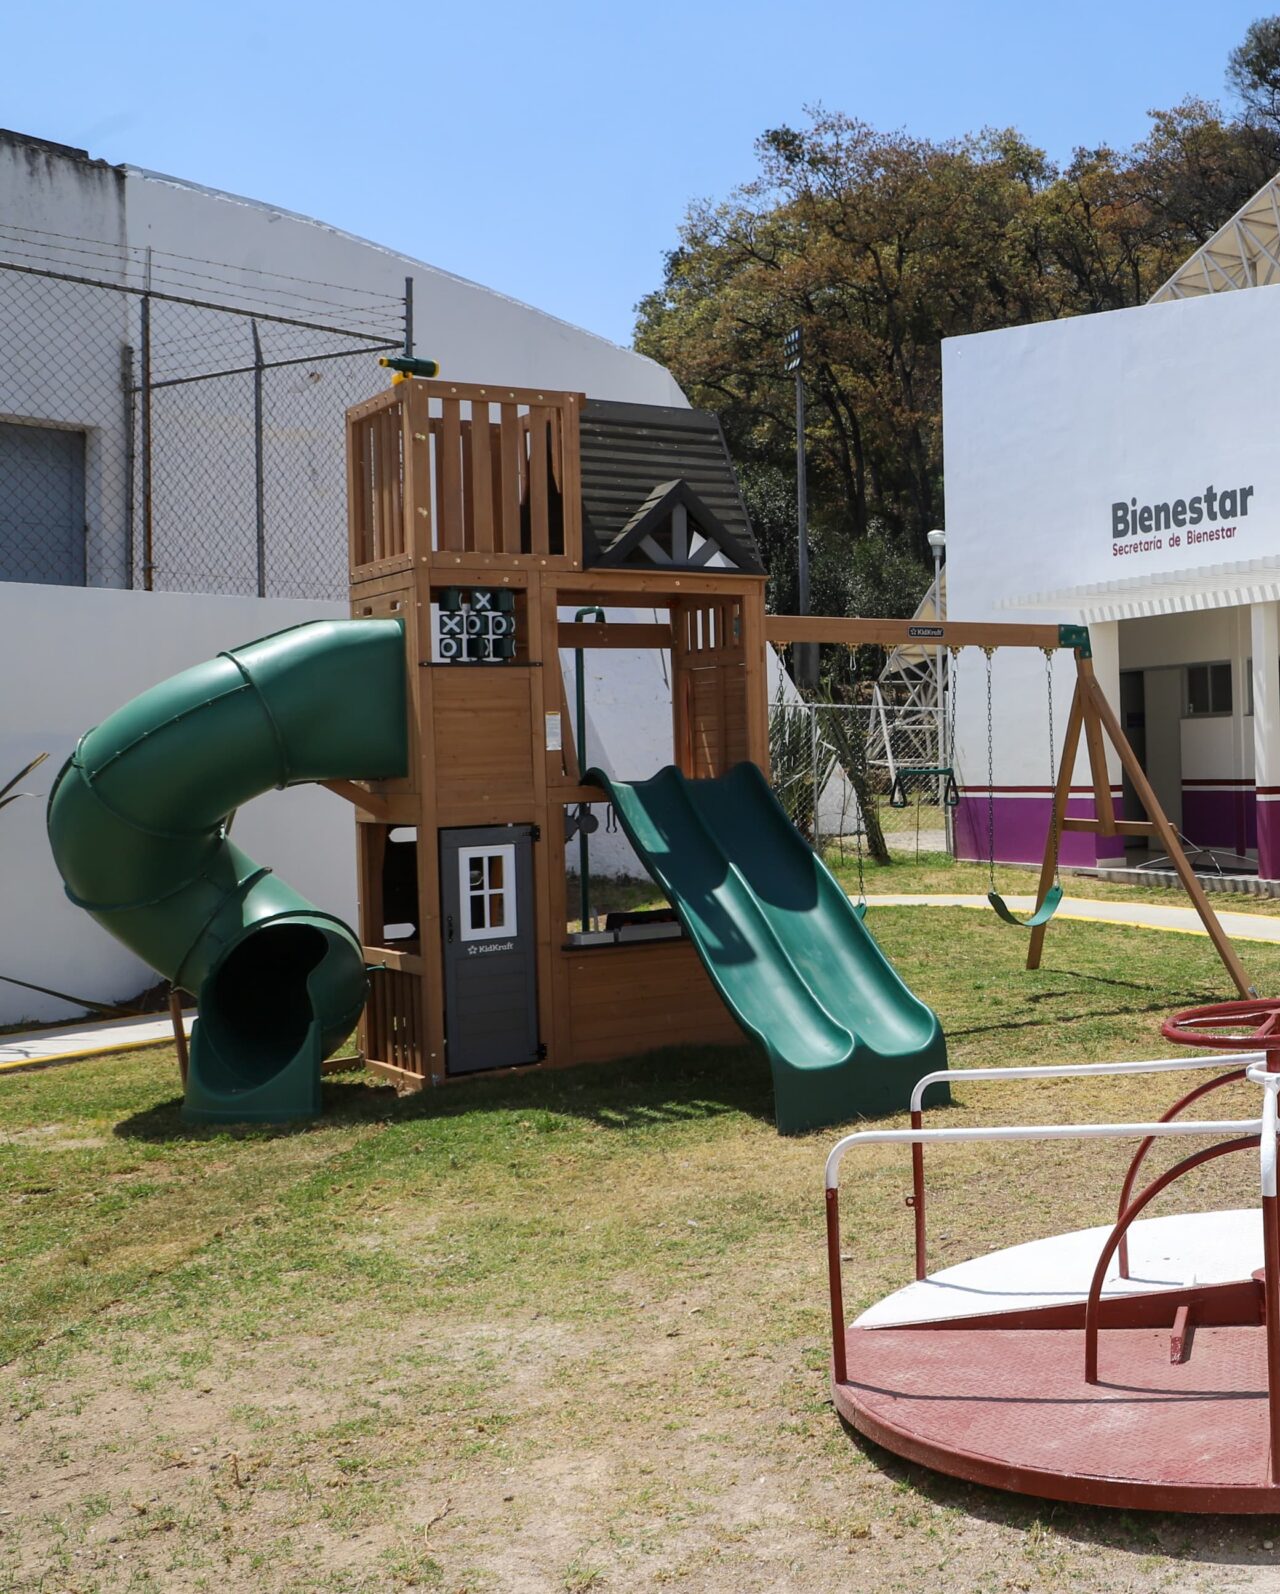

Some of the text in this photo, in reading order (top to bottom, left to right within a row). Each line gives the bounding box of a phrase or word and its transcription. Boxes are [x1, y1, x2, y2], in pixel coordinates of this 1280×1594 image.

[1112, 485, 1254, 539] Bienestar
[1112, 526, 1237, 556] Secretaría de Bienestar
[478, 941, 514, 952] KidKraft
